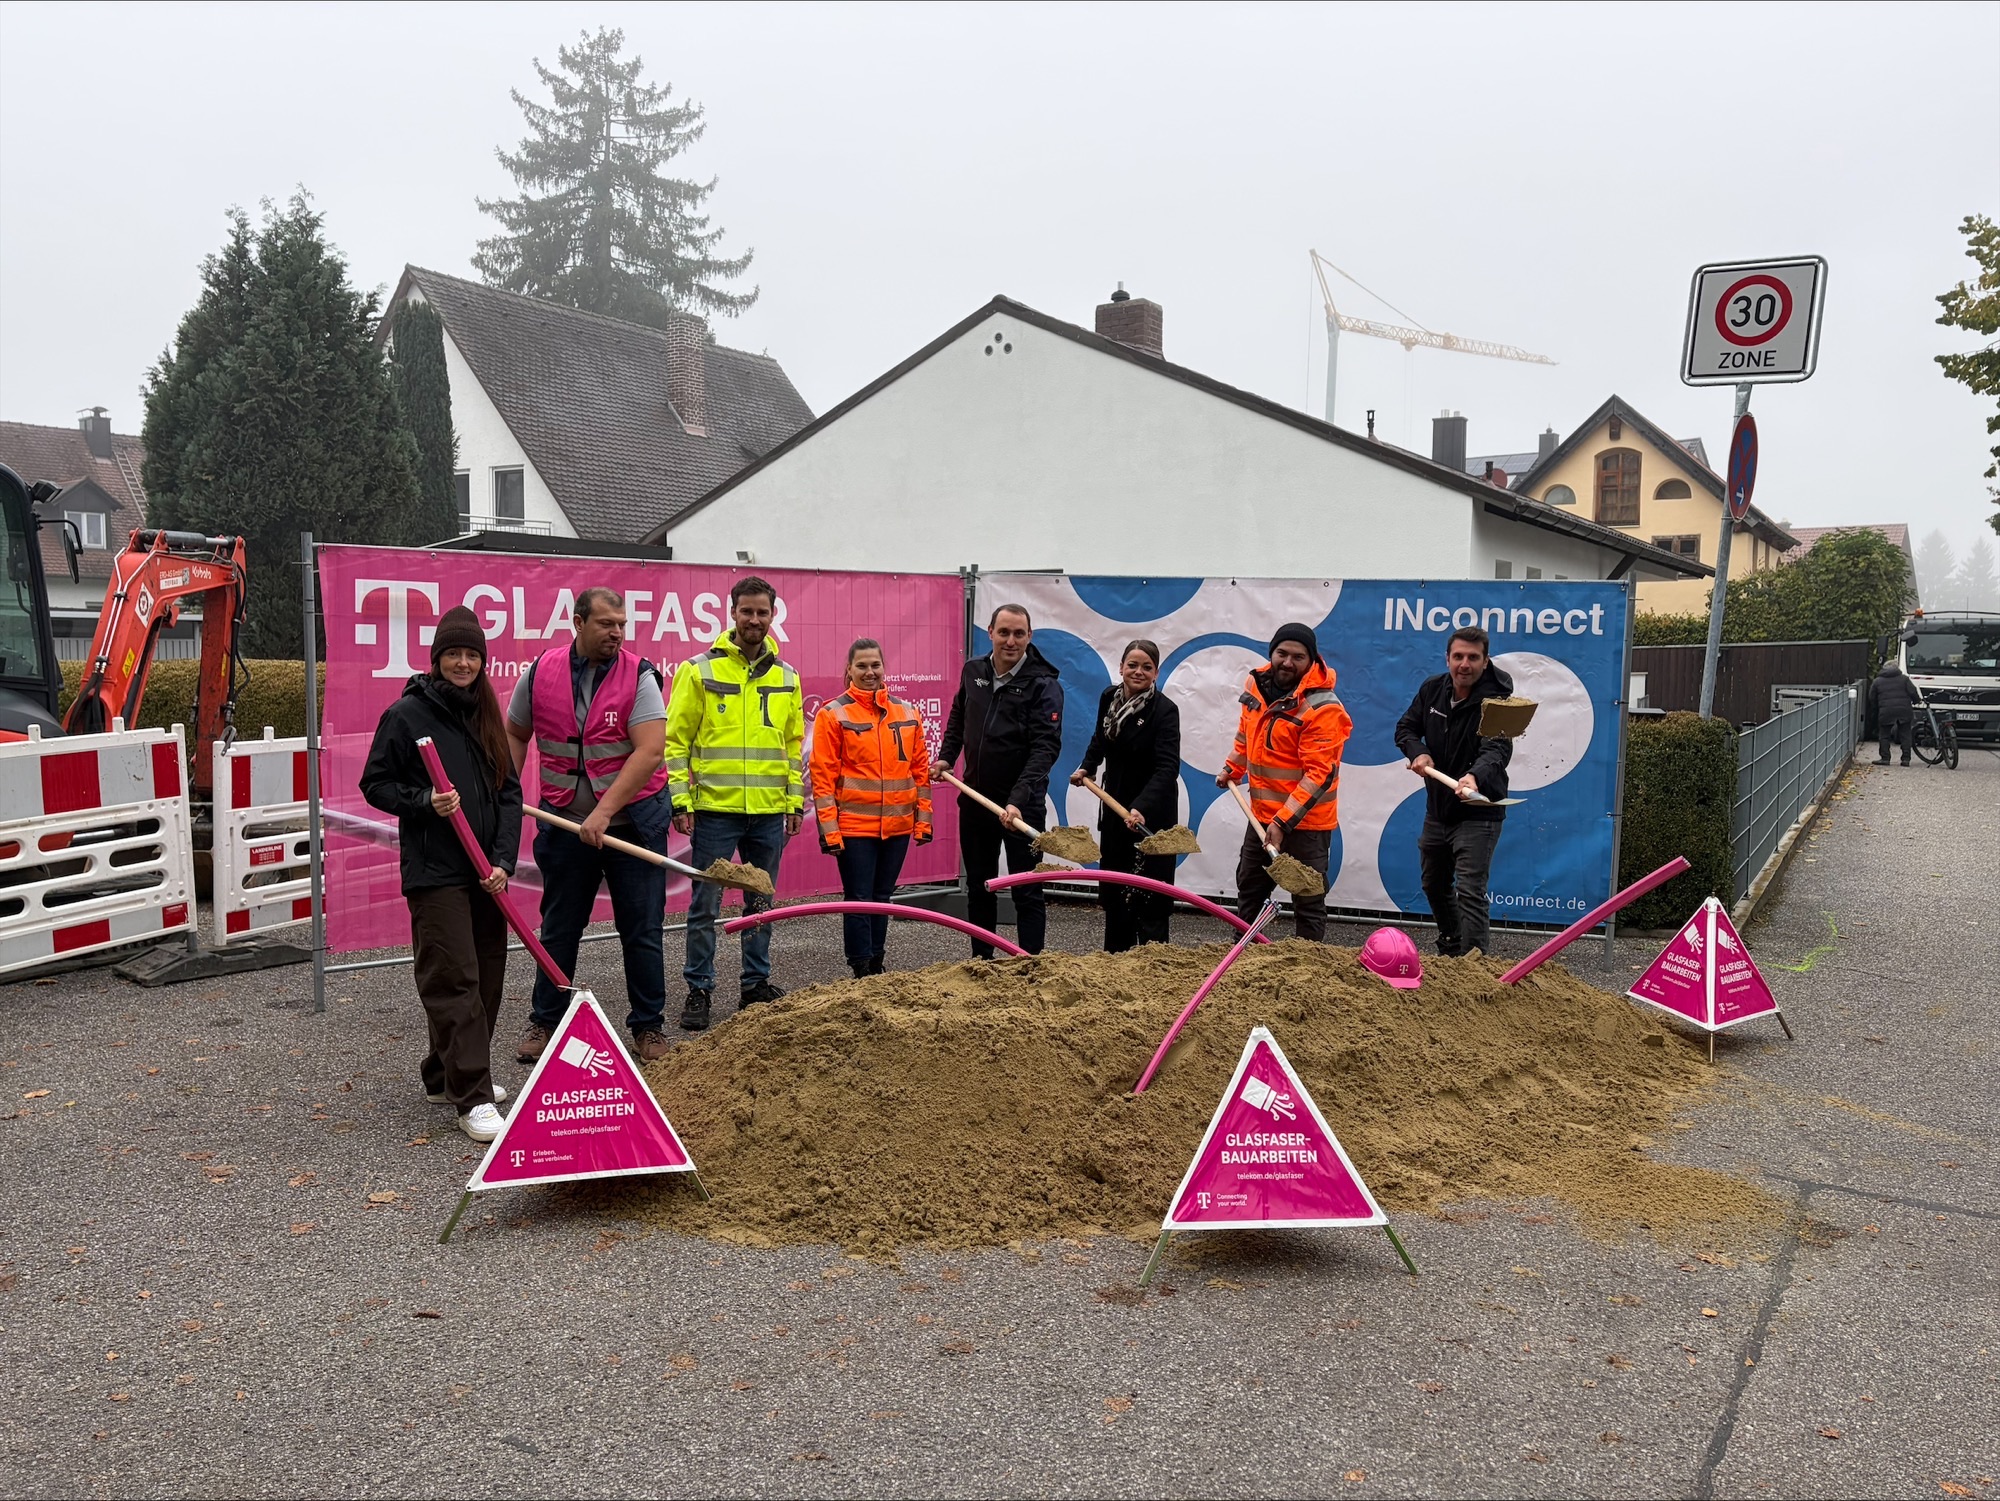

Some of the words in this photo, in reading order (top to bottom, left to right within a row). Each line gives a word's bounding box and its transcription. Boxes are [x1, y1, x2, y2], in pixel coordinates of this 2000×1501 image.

[1730, 293, 1777, 327] 30
[1717, 349, 1778, 369] ZONE
[461, 584, 790, 643] GLAFASR
[1384, 597, 1605, 635] INconnect
[883, 674, 900, 682] Jetzt
[900, 673, 941, 683] Verfügbarkeit
[887, 684, 907, 692] rüfen:
[1484, 891, 1586, 911] Nconnect.de
[1667, 951, 1701, 971] GLASFASER-
[1719, 960, 1748, 973] GLASFASER-
[1660, 960, 1702, 983] BAUARBEITEN
[541, 1087, 630, 1106] GLASFASER-
[536, 1102, 635, 1123] BAUARBEITEN
[550, 1125, 622, 1137] telekom.de/glasfaser
[1225, 1133, 1311, 1147] GLASFASER-
[545, 1154, 574, 1163] verbindet.
[1221, 1150, 1318, 1164] BAUARBEITEN
[1237, 1172, 1304, 1181] telekom.de/glasfaser
[1216, 1193, 1248, 1201] Connecting
